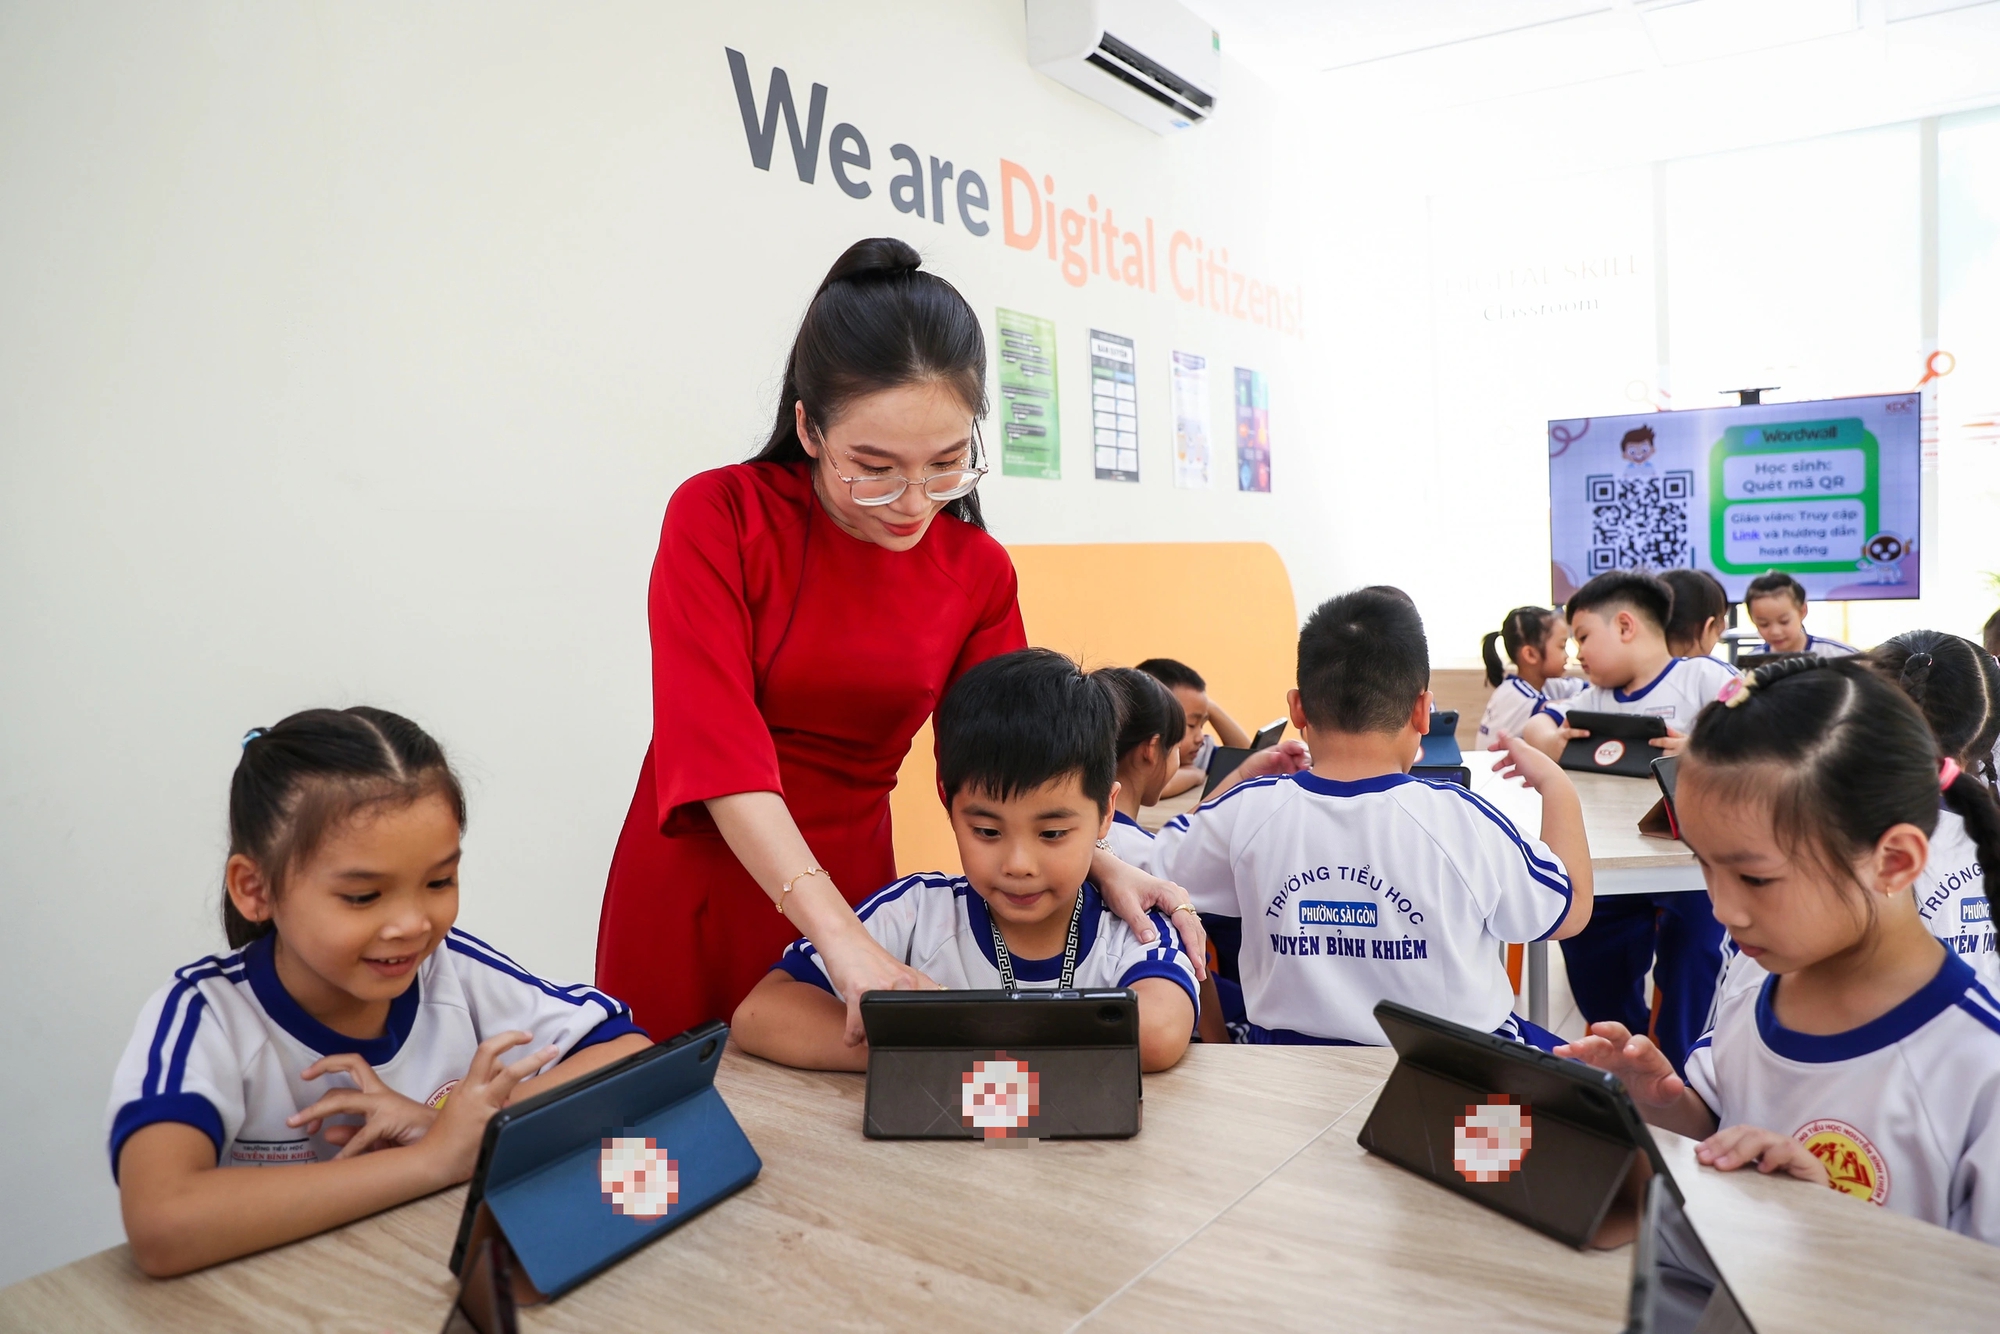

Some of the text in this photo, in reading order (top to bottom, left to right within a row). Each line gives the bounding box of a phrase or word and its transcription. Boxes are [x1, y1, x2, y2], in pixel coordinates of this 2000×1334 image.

[725, 46, 1306, 341] We are Digital Citizens!
[1564, 254, 1639, 279] SKILL
[1484, 299, 1599, 321] Classroom
[1762, 426, 1838, 443] Wordwall
[1755, 463, 1787, 475] Học
[1742, 475, 1845, 494] Quét mã QR
[1800, 509, 1829, 522] Truy
[1732, 530, 1760, 541] Link
[1265, 864, 1424, 925] TRƯỜNG TIỂU HỌC
[1918, 862, 1983, 920] TRƯỜNG
[1301, 905, 1376, 925] PHƯỜNG SÀI GÒN
[1962, 900, 1990, 920] PHƯỜNG
[1326, 929, 1366, 958] BỈNH
[1372, 935, 1428, 961] KHIÊM
